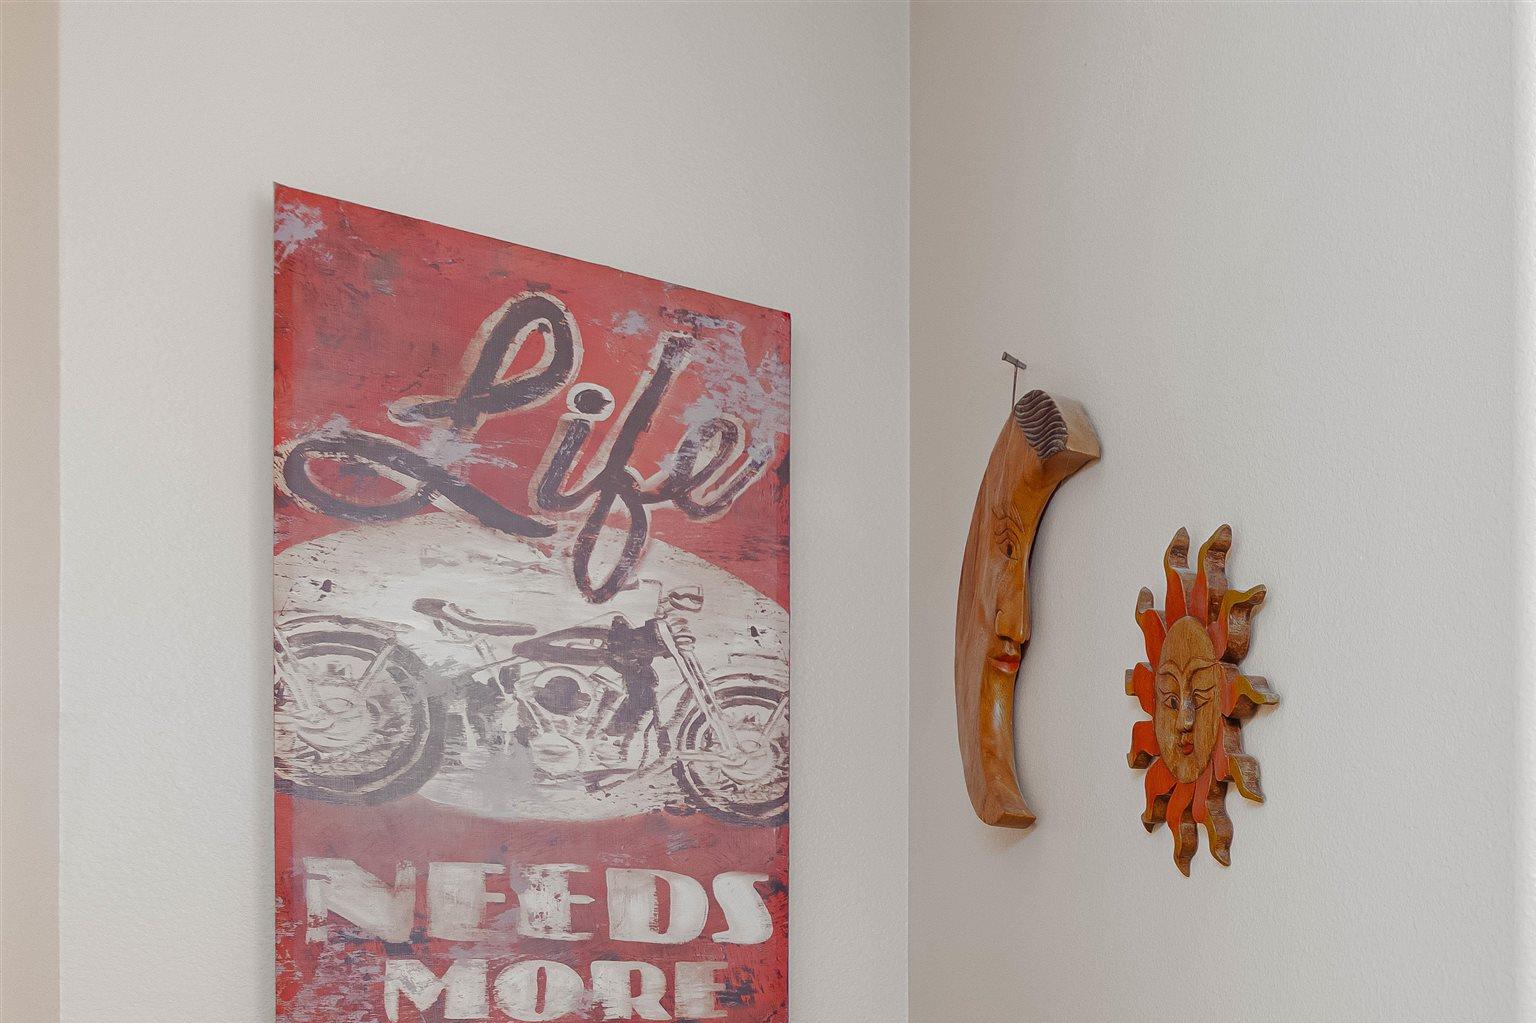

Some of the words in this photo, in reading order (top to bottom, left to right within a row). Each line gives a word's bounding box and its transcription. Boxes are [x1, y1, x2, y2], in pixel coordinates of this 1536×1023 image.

[274, 290, 776, 605] Life
[302, 857, 775, 945] NEEDS
[384, 958, 729, 1023] MORE
